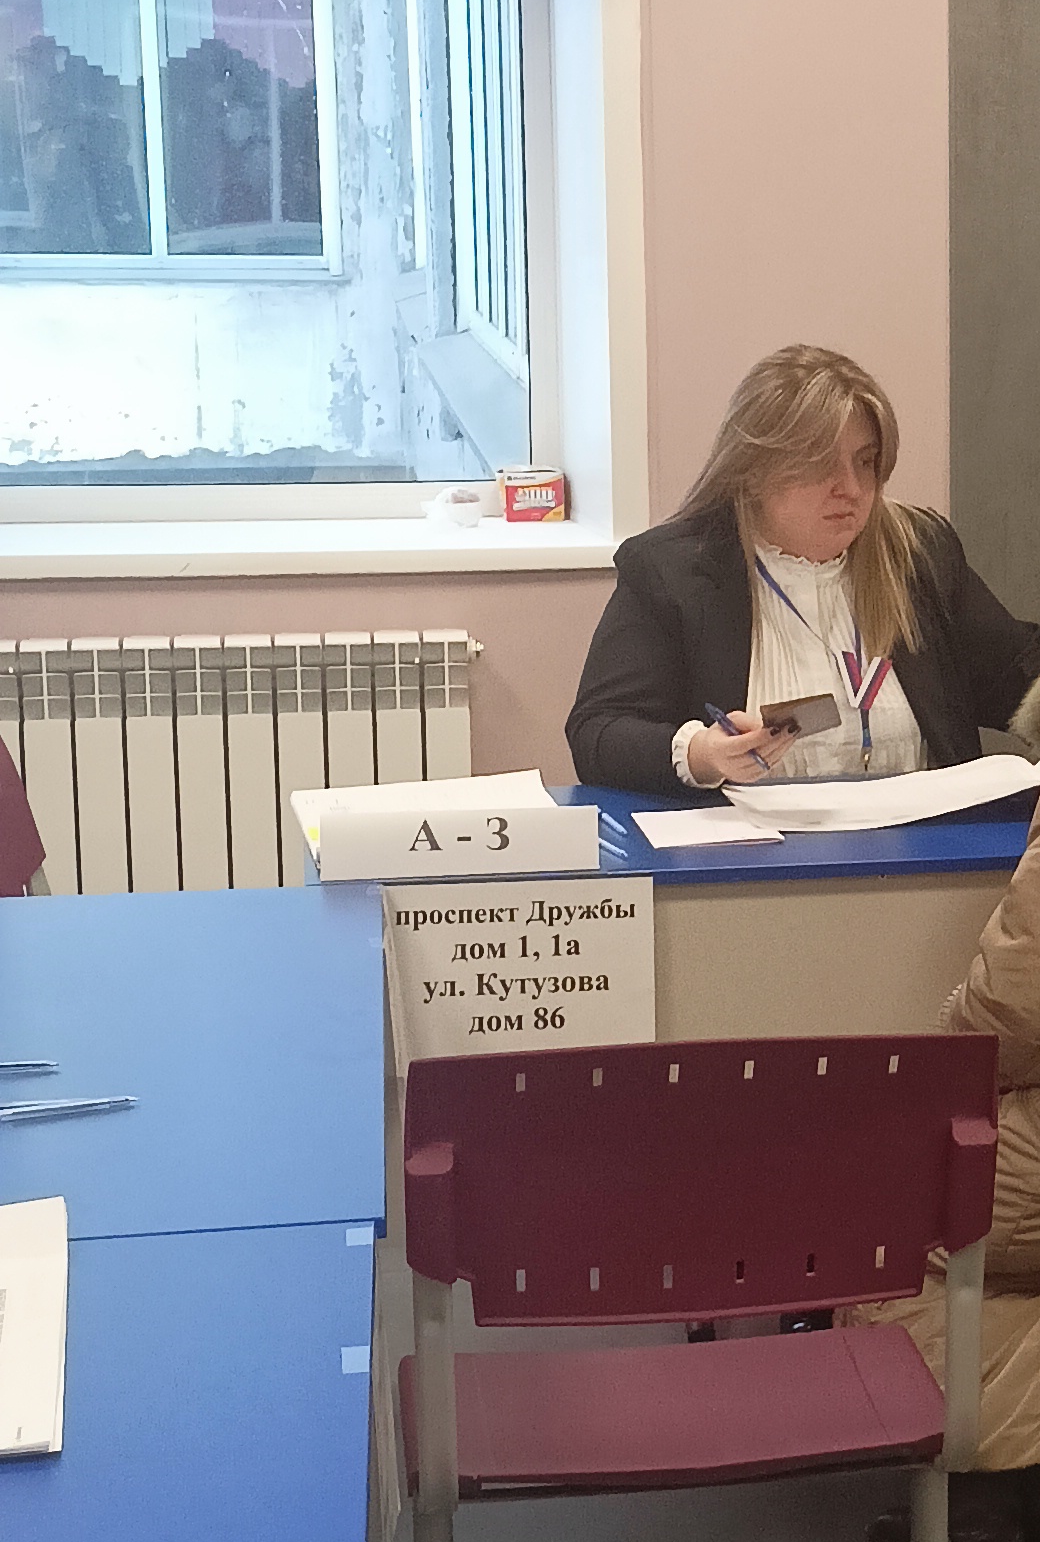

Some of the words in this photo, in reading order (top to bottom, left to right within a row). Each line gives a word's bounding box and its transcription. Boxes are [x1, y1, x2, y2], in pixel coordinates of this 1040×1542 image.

[409, 819, 443, 851] А
[395, 907, 520, 930] проспект
[526, 900, 636, 929] Дружбы
[451, 940, 506, 962] дом
[518, 935, 540, 961] 1,
[551, 934, 581, 957] 1а
[423, 977, 466, 1003] ул.
[476, 973, 610, 1001] Кутузова
[469, 1012, 523, 1035] дом
[533, 1007, 566, 1031] 86
